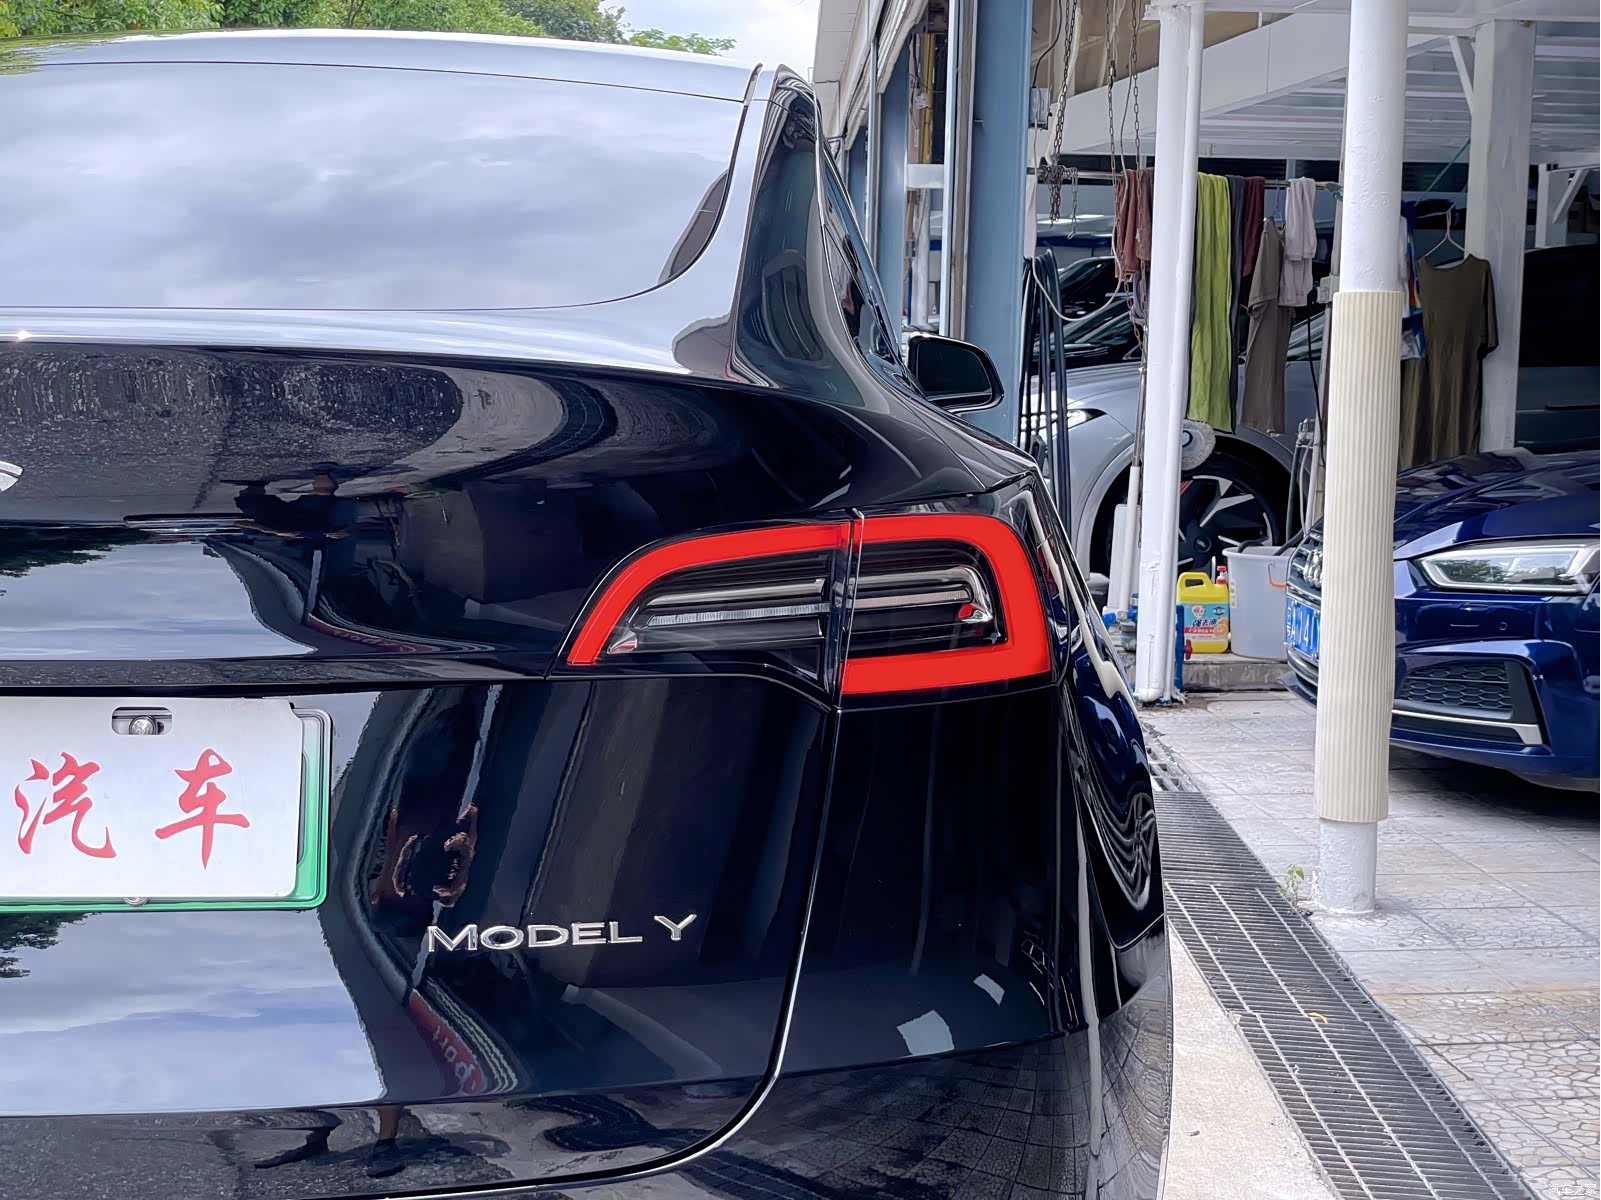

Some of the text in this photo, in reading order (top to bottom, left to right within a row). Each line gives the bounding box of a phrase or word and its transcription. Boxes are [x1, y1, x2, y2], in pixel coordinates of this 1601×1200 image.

[14, 748, 250, 870] 汽车
[427, 914, 697, 952] MODEL Y
